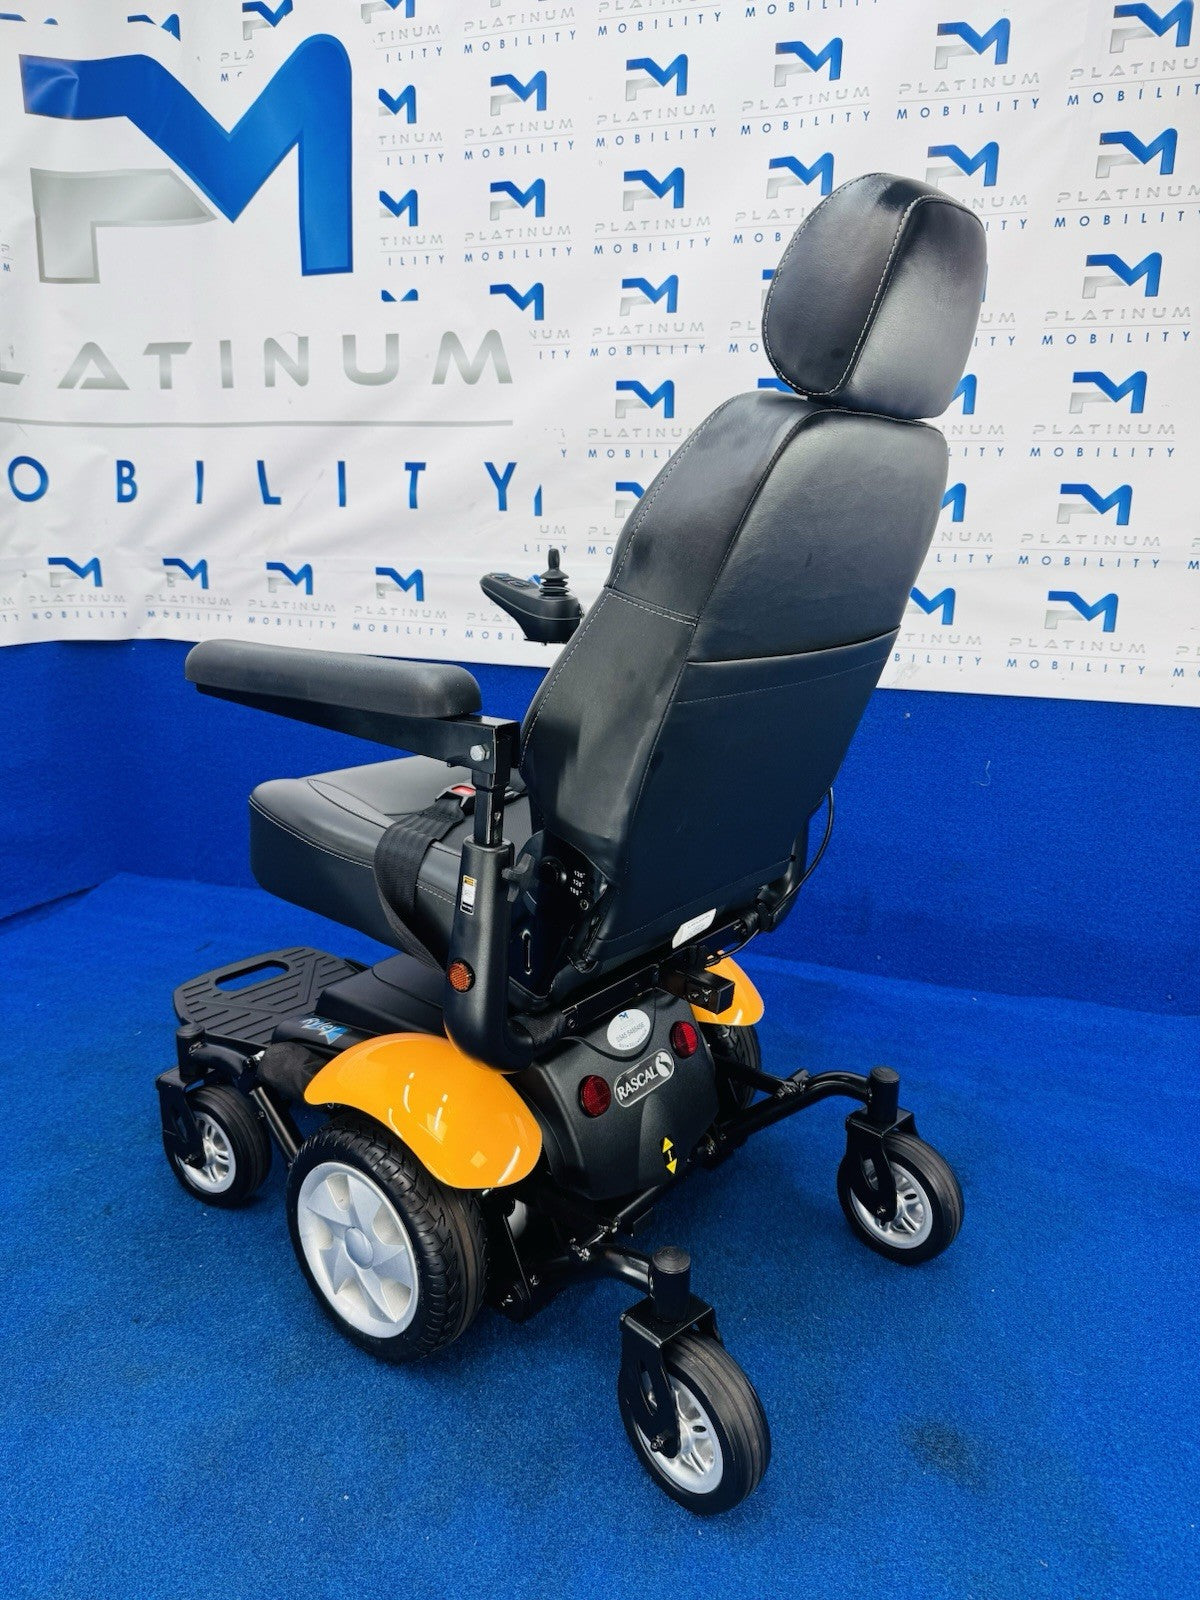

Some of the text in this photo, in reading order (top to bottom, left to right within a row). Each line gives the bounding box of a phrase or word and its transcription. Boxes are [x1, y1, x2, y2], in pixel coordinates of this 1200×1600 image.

[464, 7, 575, 32] PLATINUM
[597, 11, 722, 35] MOBILITY
[376, 24, 441, 43] TINUM
[464, 30, 576, 53] MOBILITY
[898, 72, 1040, 94] PLATINUM
[742, 87, 870, 112] PLATINUM
[597, 104, 715, 124] PLATINUM
[896, 98, 1040, 120] MOBILITY
[464, 118, 573, 139] PLATINUM
[740, 111, 871, 135] MOBILITY
[595, 127, 717, 147] MOBILITY
[464, 140, 574, 160] MOBILITY
[595, 216, 711, 233] PLATINUM
[1055, 211, 1200, 227] MOBILIT
[464, 225, 571, 242] PLATINUM
[592, 238, 711, 255] MOBILITY
[464, 247, 573, 263] MOBILITY
[1045, 307, 1191, 322] PLATINUM
[592, 322, 704, 336] PLATINUM
[1040, 331, 1190, 345] MOBILITY
[589, 344, 705, 357] MOBILITY
[1032, 424, 1175, 436] PLATINUM
[1029, 447, 1175, 457] MOBILITY
[6, 455, 517, 512] OBILITY
[1020, 533, 1160, 547] PLATINUM
[1017, 555, 1160, 568] MOBILITY
[145, 594, 231, 605] PLATINUM
[248, 599, 336, 612] PLATINUM
[148, 610, 232, 622] MOBILITY
[354, 606, 447, 619] PLATINUM
[248, 617, 336, 629] MOBILITY
[353, 623, 447, 636] MOBILITY
[902, 633, 982, 645] TINUM
[1009, 637, 1146, 653] PLATINUM
[1006, 658, 1145, 675] MOBILITY
[617, 1066, 658, 1100] RASCAL
